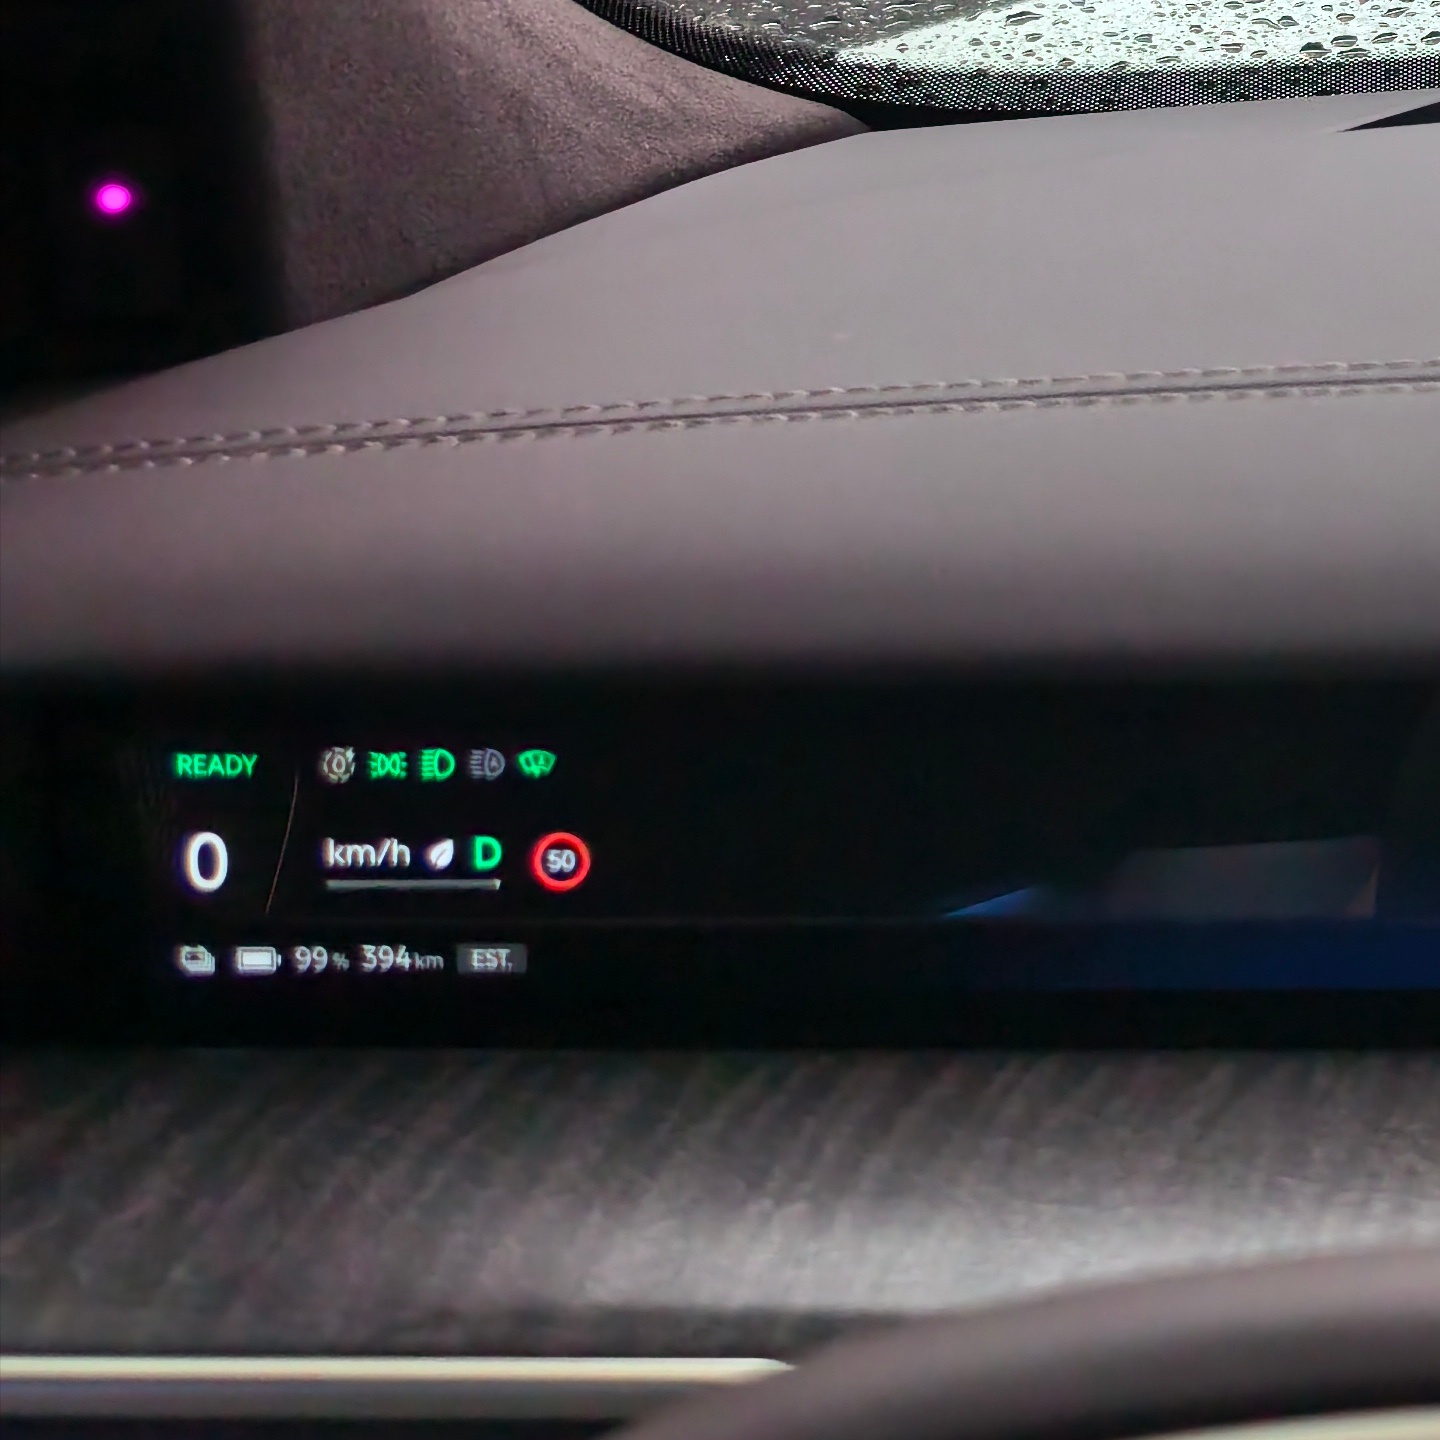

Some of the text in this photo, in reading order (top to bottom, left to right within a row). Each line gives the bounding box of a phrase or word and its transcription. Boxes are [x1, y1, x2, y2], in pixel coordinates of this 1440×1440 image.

[175, 751, 258, 779] READY
[184, 831, 229, 893] 0
[322, 836, 411, 868] km/h
[472, 835, 502, 870] D
[546, 849, 576, 872] 50
